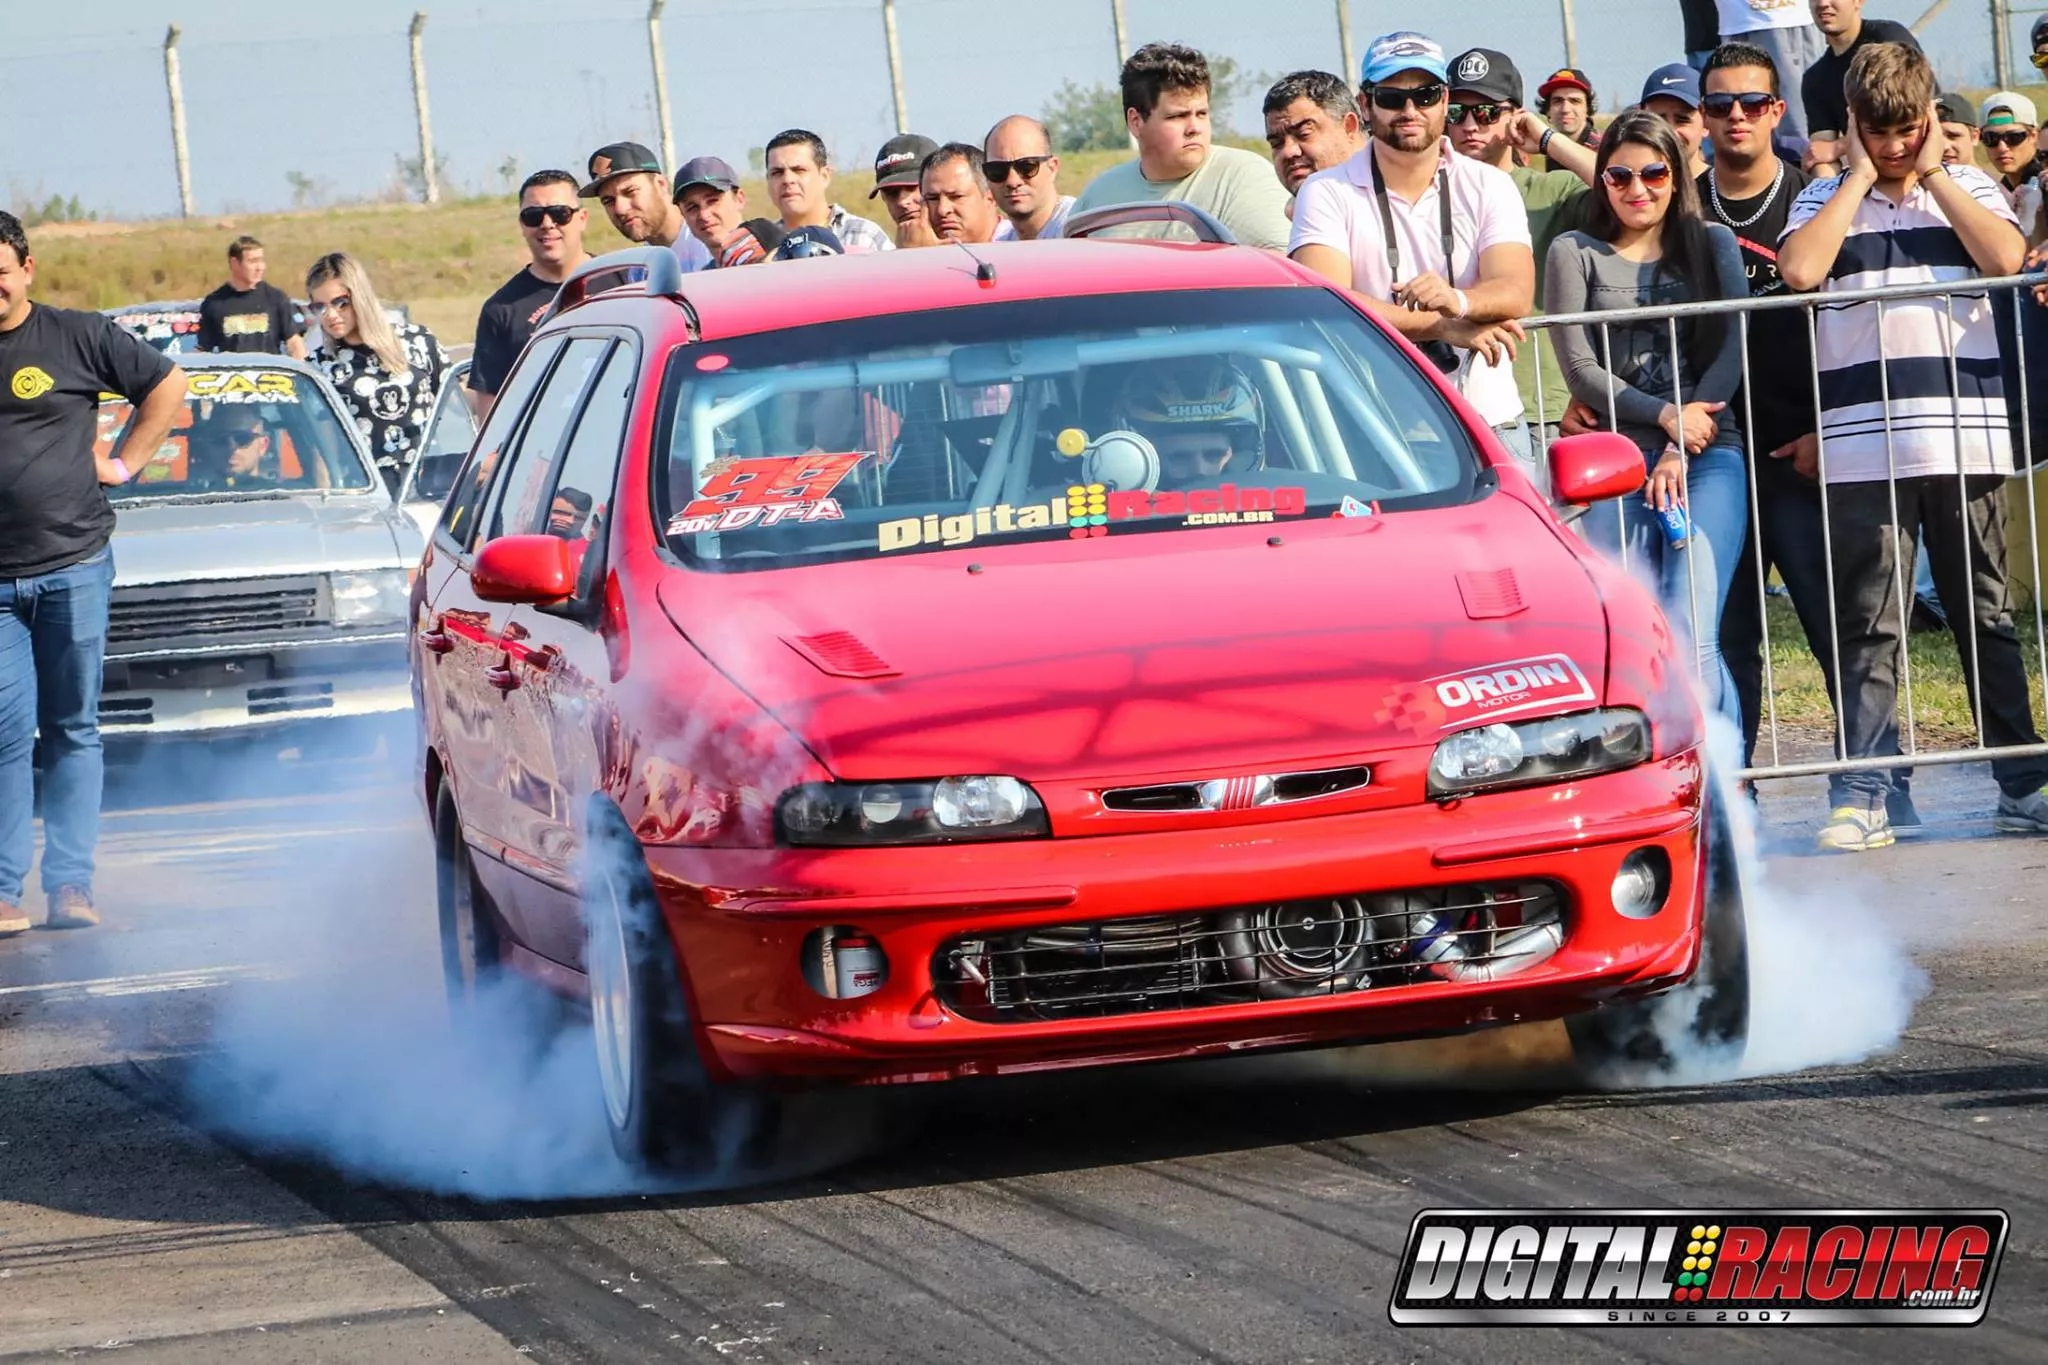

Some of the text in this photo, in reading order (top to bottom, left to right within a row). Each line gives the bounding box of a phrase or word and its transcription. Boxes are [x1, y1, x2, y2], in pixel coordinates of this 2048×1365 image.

[1167, 404, 1228, 417] SHARK
[878, 483, 1306, 552] Digital Racing
[1477, 691, 1531, 709] MOTOR
